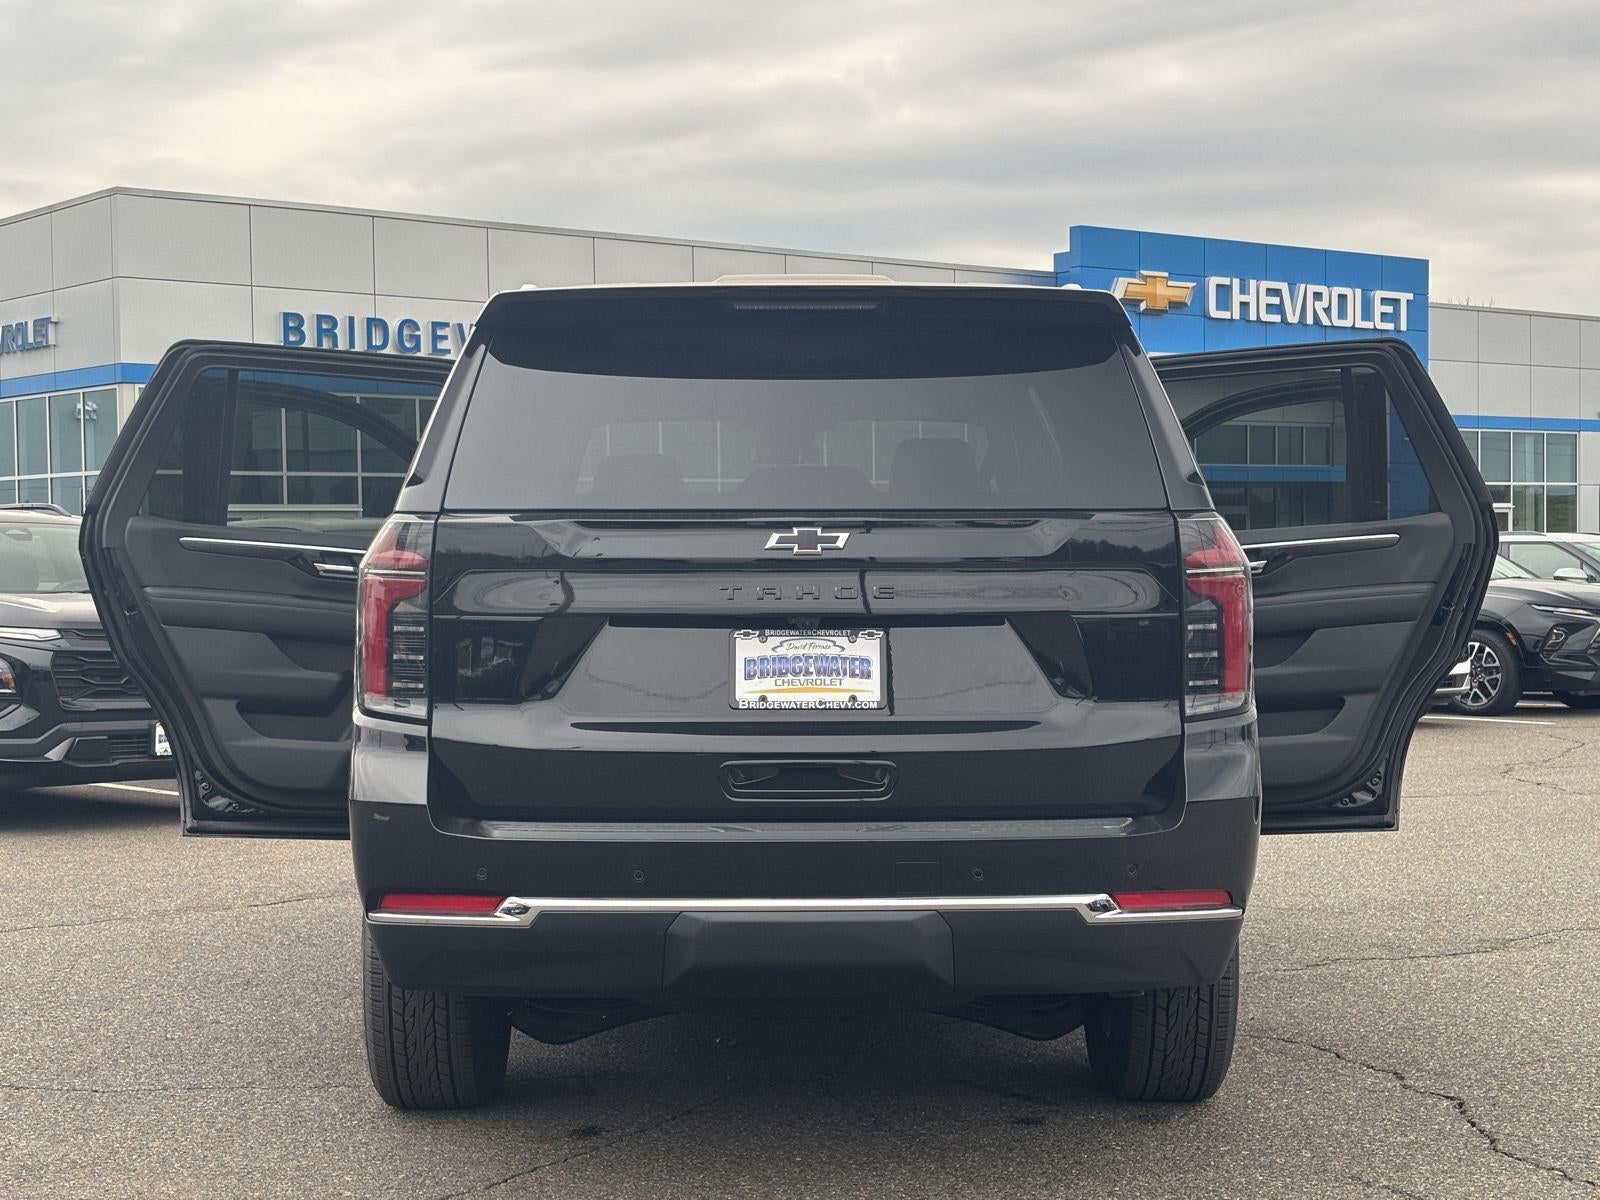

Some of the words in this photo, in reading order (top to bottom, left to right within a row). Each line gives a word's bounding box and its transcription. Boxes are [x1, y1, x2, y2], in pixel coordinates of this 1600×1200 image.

[1207, 276, 1414, 332] CHEVROLET
[0, 316, 57, 354] ROLET
[281, 311, 474, 356] BRIDGE
[720, 585, 895, 600] TAHOE
[744, 653, 873, 681] BRIDGEWATER
[774, 677, 844, 686] CHEVROLET
